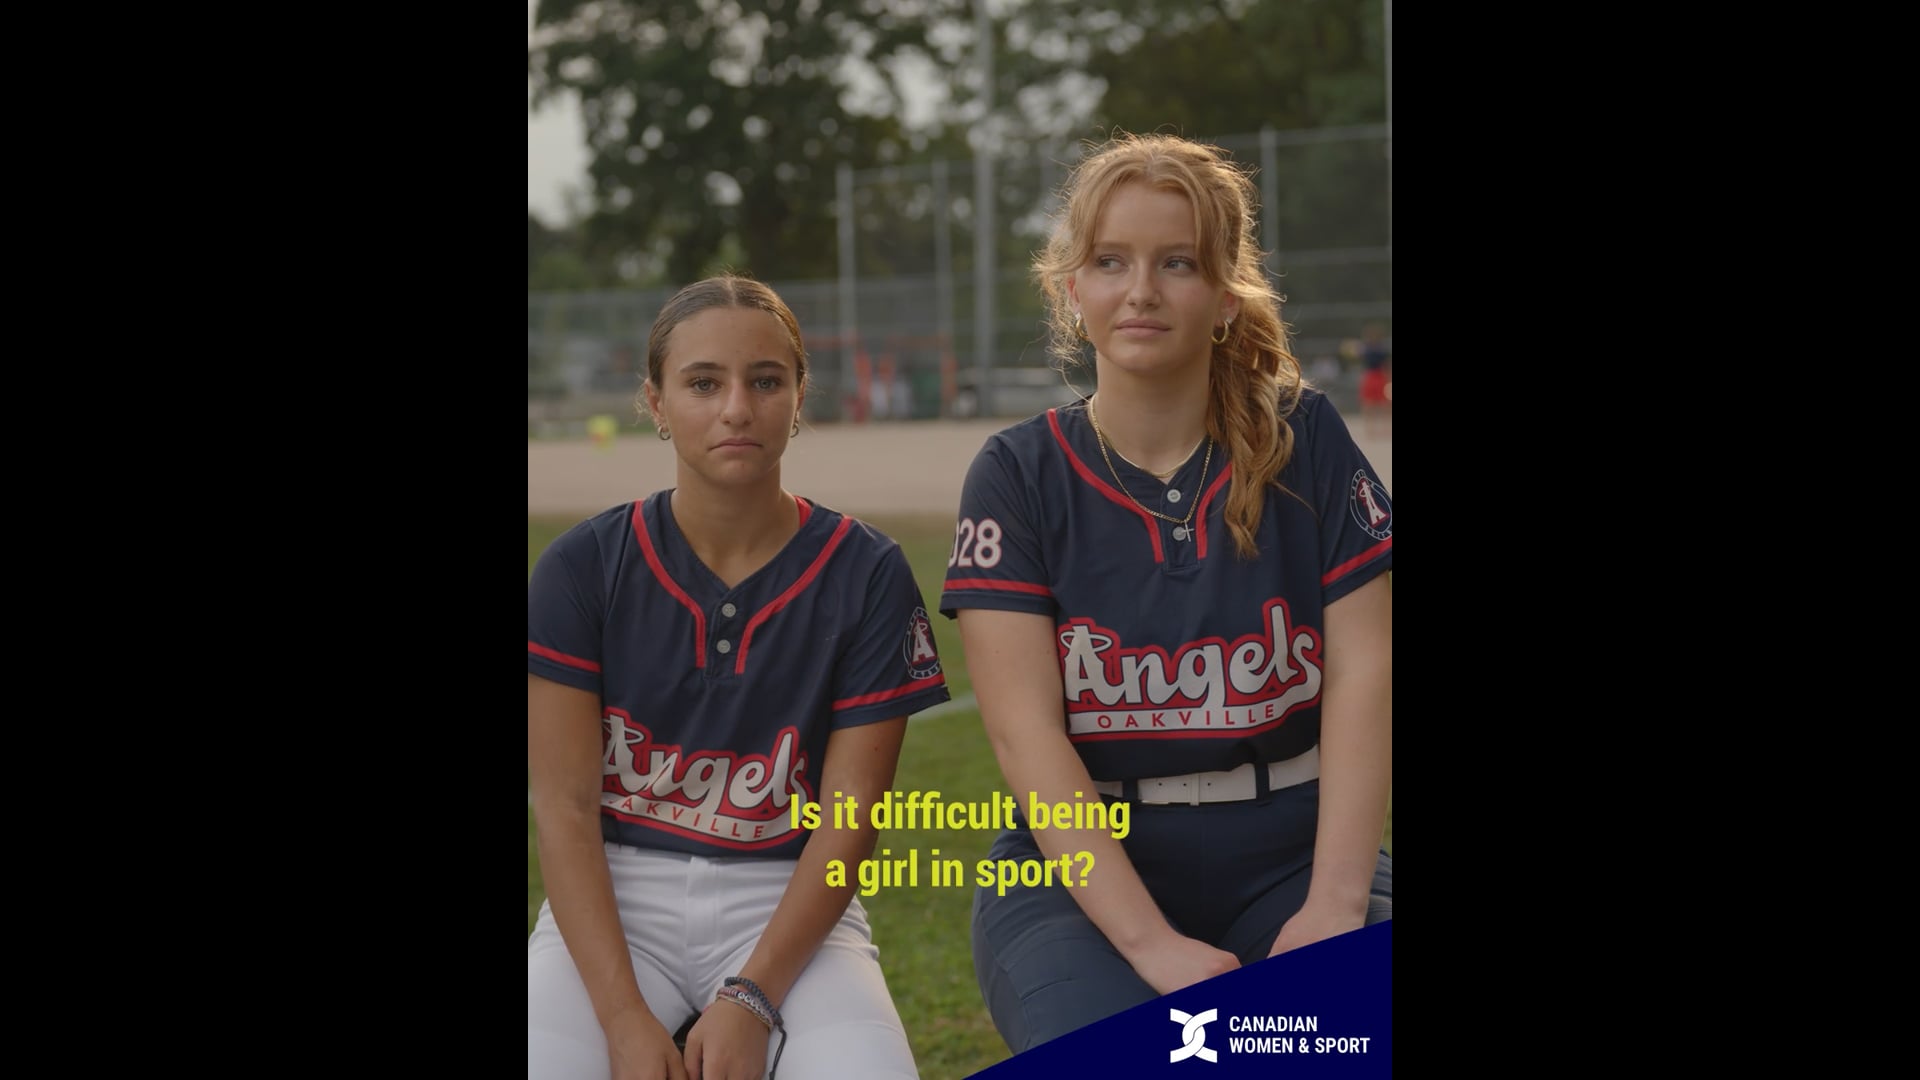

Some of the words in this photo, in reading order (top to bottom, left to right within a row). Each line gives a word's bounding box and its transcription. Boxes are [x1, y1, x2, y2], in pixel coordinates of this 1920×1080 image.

[1059, 605, 1322, 707] Angels
[1097, 703, 1275, 730] OAKVILLE
[602, 713, 808, 816] Angels
[608, 796, 765, 838] AKVILLE
